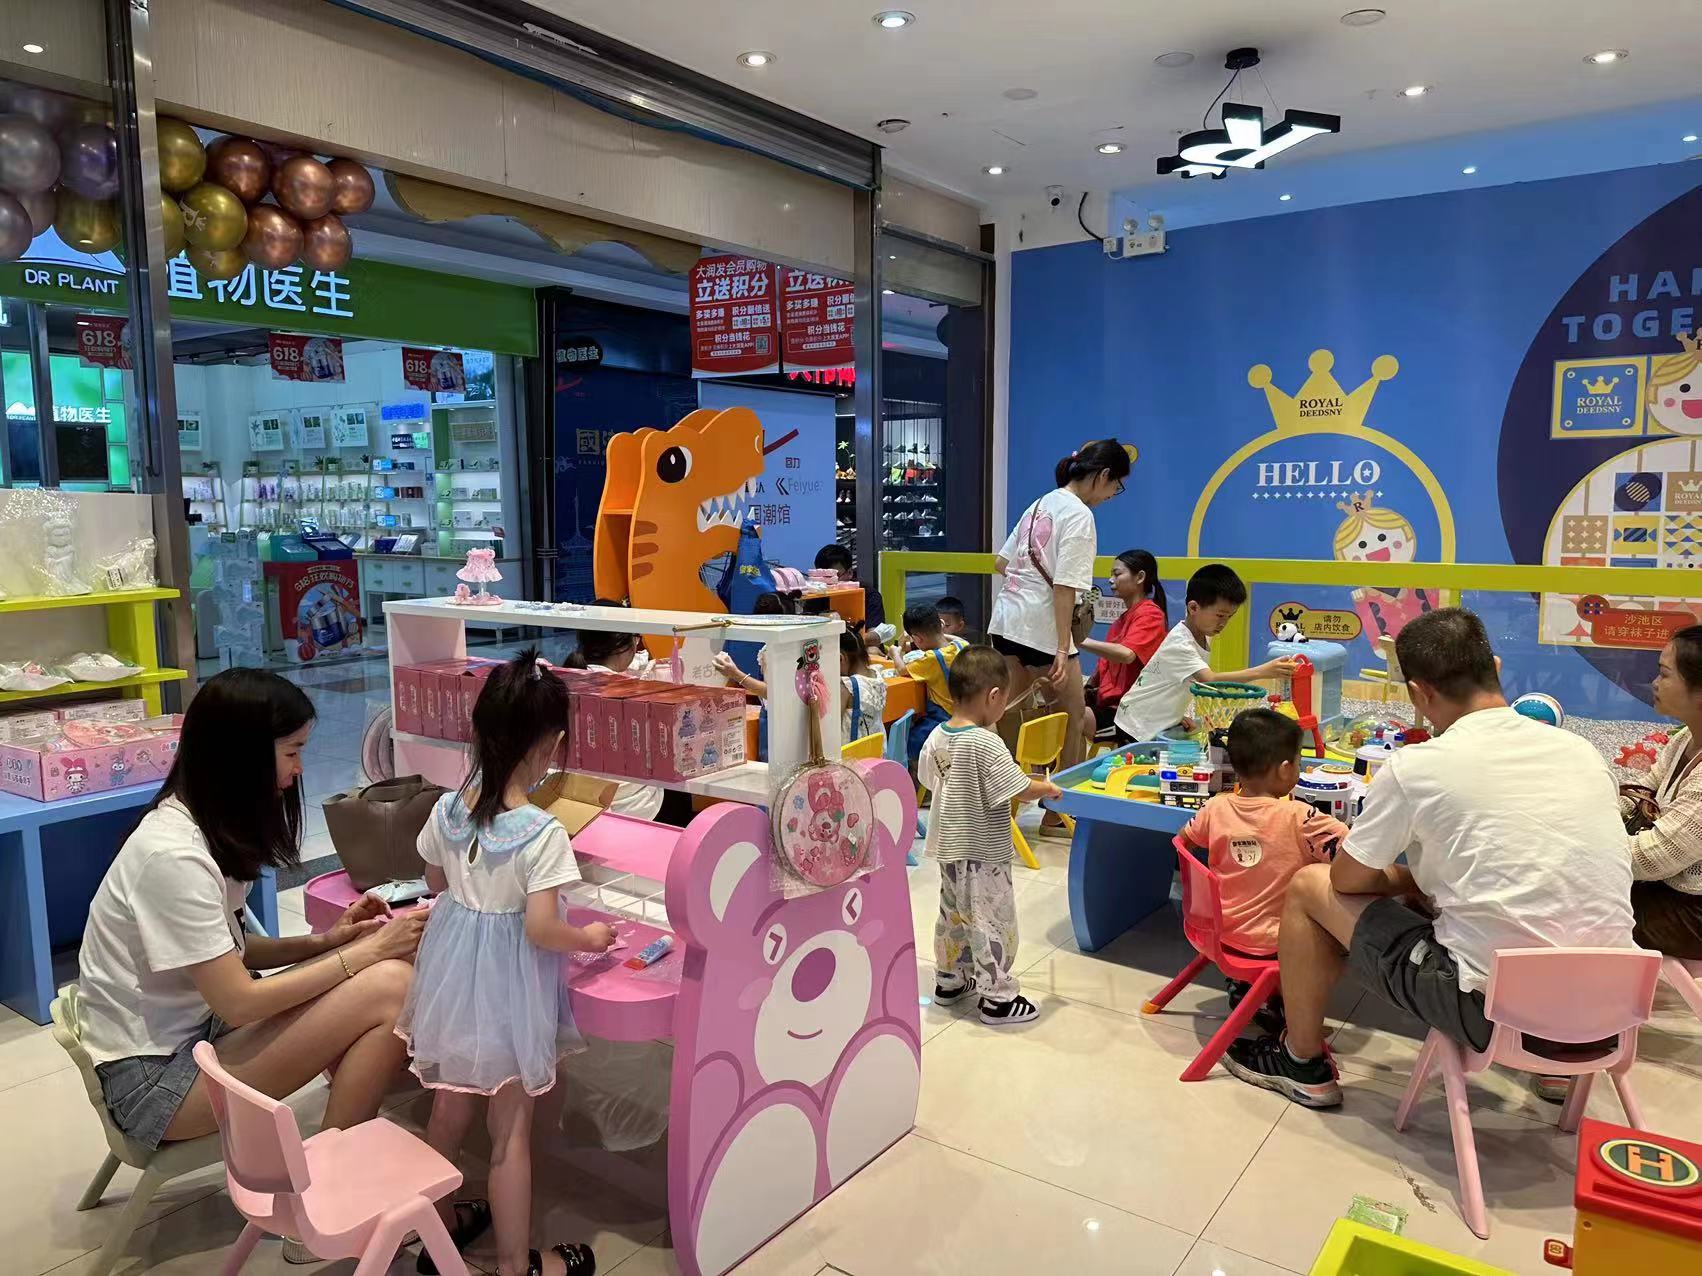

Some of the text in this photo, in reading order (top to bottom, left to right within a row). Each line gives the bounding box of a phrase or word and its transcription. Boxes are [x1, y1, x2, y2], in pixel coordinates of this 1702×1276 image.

[695, 260, 767, 279] 大润发会员购物
[24, 268, 119, 294] DR PLANT
[695, 273, 769, 301] 立送积分
[1561, 307, 1693, 343] TOGE
[81, 330, 117, 347] 618
[273, 346, 300, 362] 618
[405, 360, 427, 374] 618
[1299, 397, 1343, 409] ROYAL
[1577, 396, 1622, 407] ROYAL
[1299, 408, 1343, 418] DEEDSNY
[1576, 405, 1622, 415] DEEDSNY
[1256, 459, 1381, 487] HELLO
[1674, 492, 1702, 500] ROYA
[1353, 501, 1364, 512] R
[1323, 615, 1341, 624] 请勿
[1624, 614, 1664, 626] 沙池区
[1314, 623, 1351, 632] 店内饮食
[1626, 1144, 1675, 1182] H
